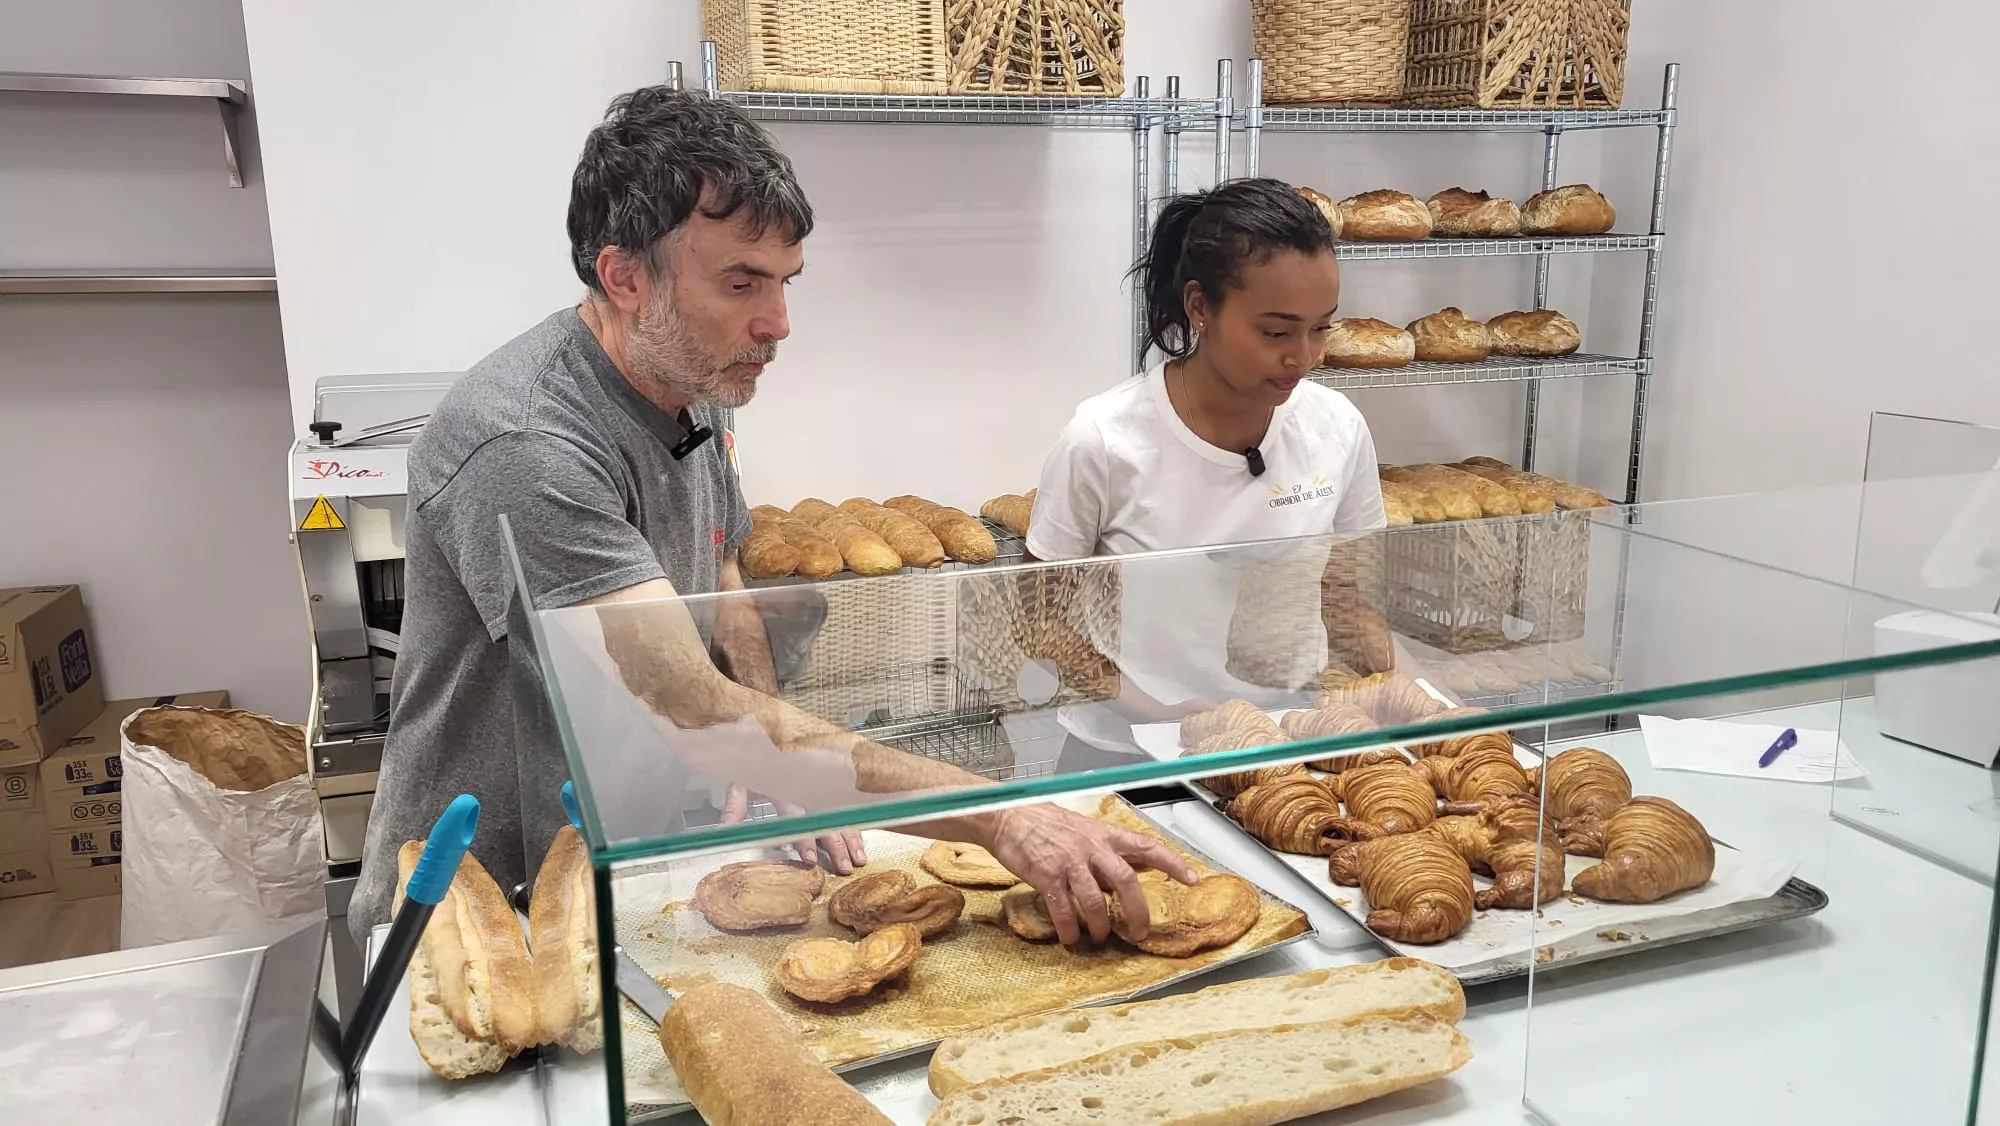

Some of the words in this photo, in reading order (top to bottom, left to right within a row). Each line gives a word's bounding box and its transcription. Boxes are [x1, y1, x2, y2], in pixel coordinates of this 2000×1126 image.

[1302, 491, 1314, 501] DE
[61, 637, 85, 665] Font
[64, 656, 90, 687] Vella
